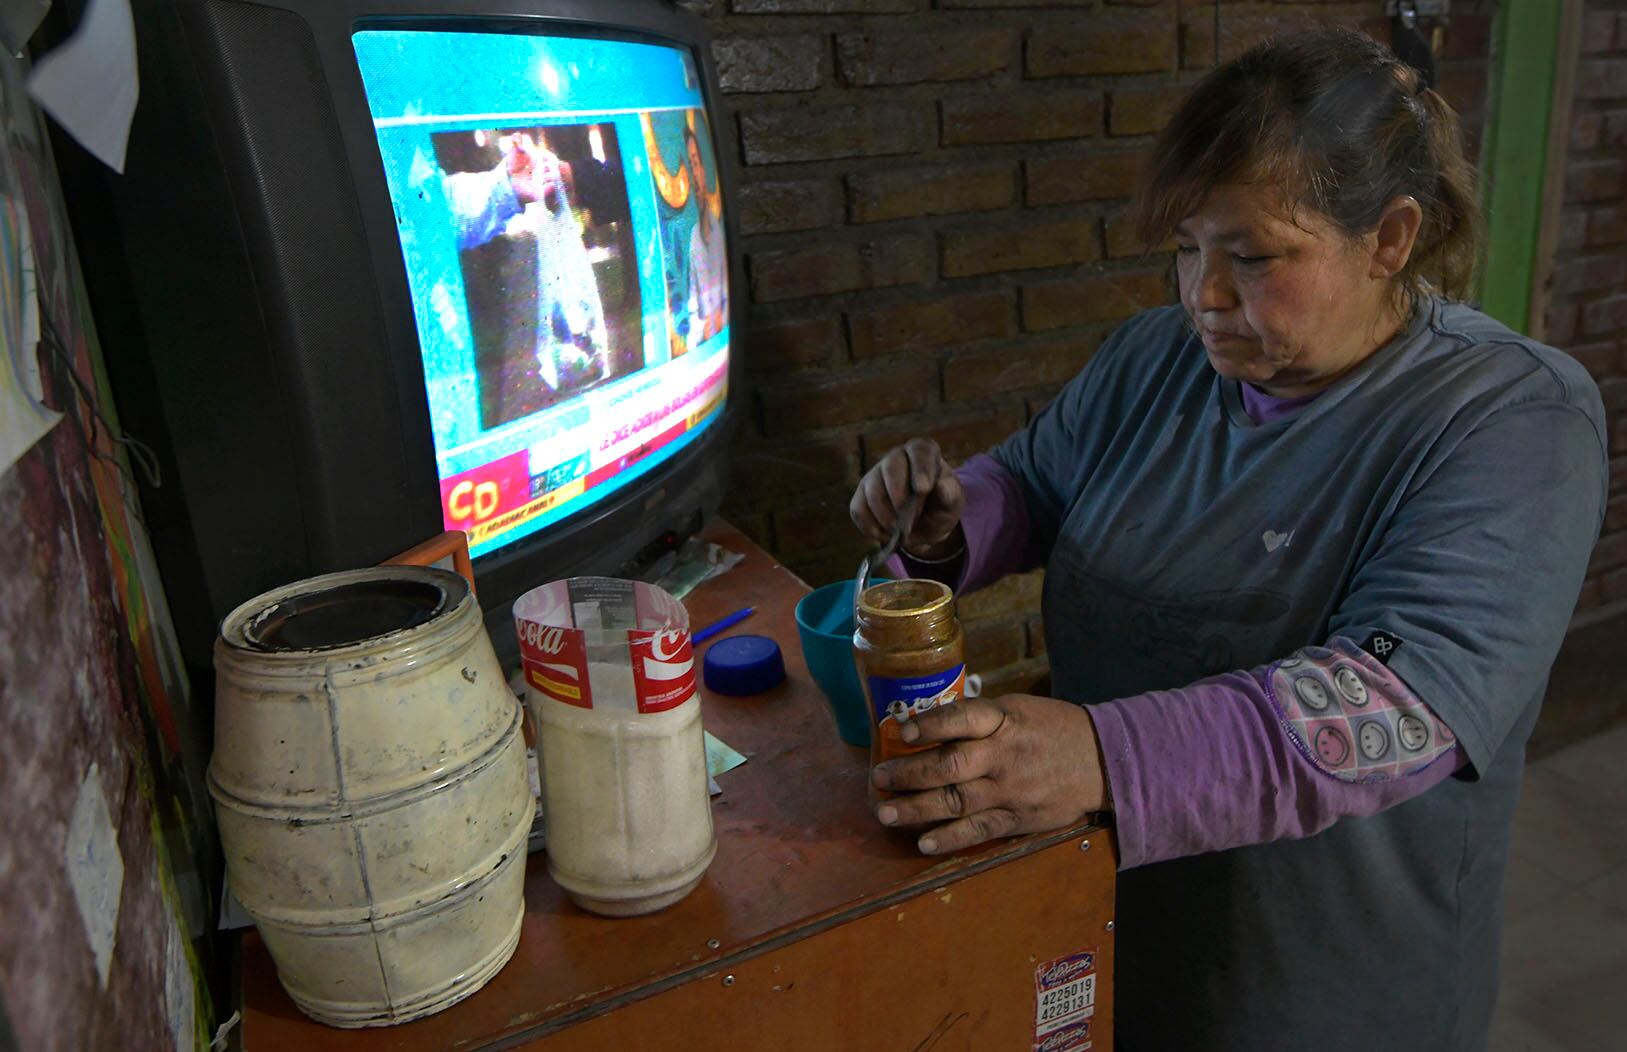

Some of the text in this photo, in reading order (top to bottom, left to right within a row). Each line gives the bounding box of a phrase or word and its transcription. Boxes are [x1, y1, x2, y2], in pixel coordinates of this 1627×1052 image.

[448, 481, 499, 520] CD
[1042, 978, 1092, 1006] 4225019
[1041, 993, 1090, 1021] 4229131
